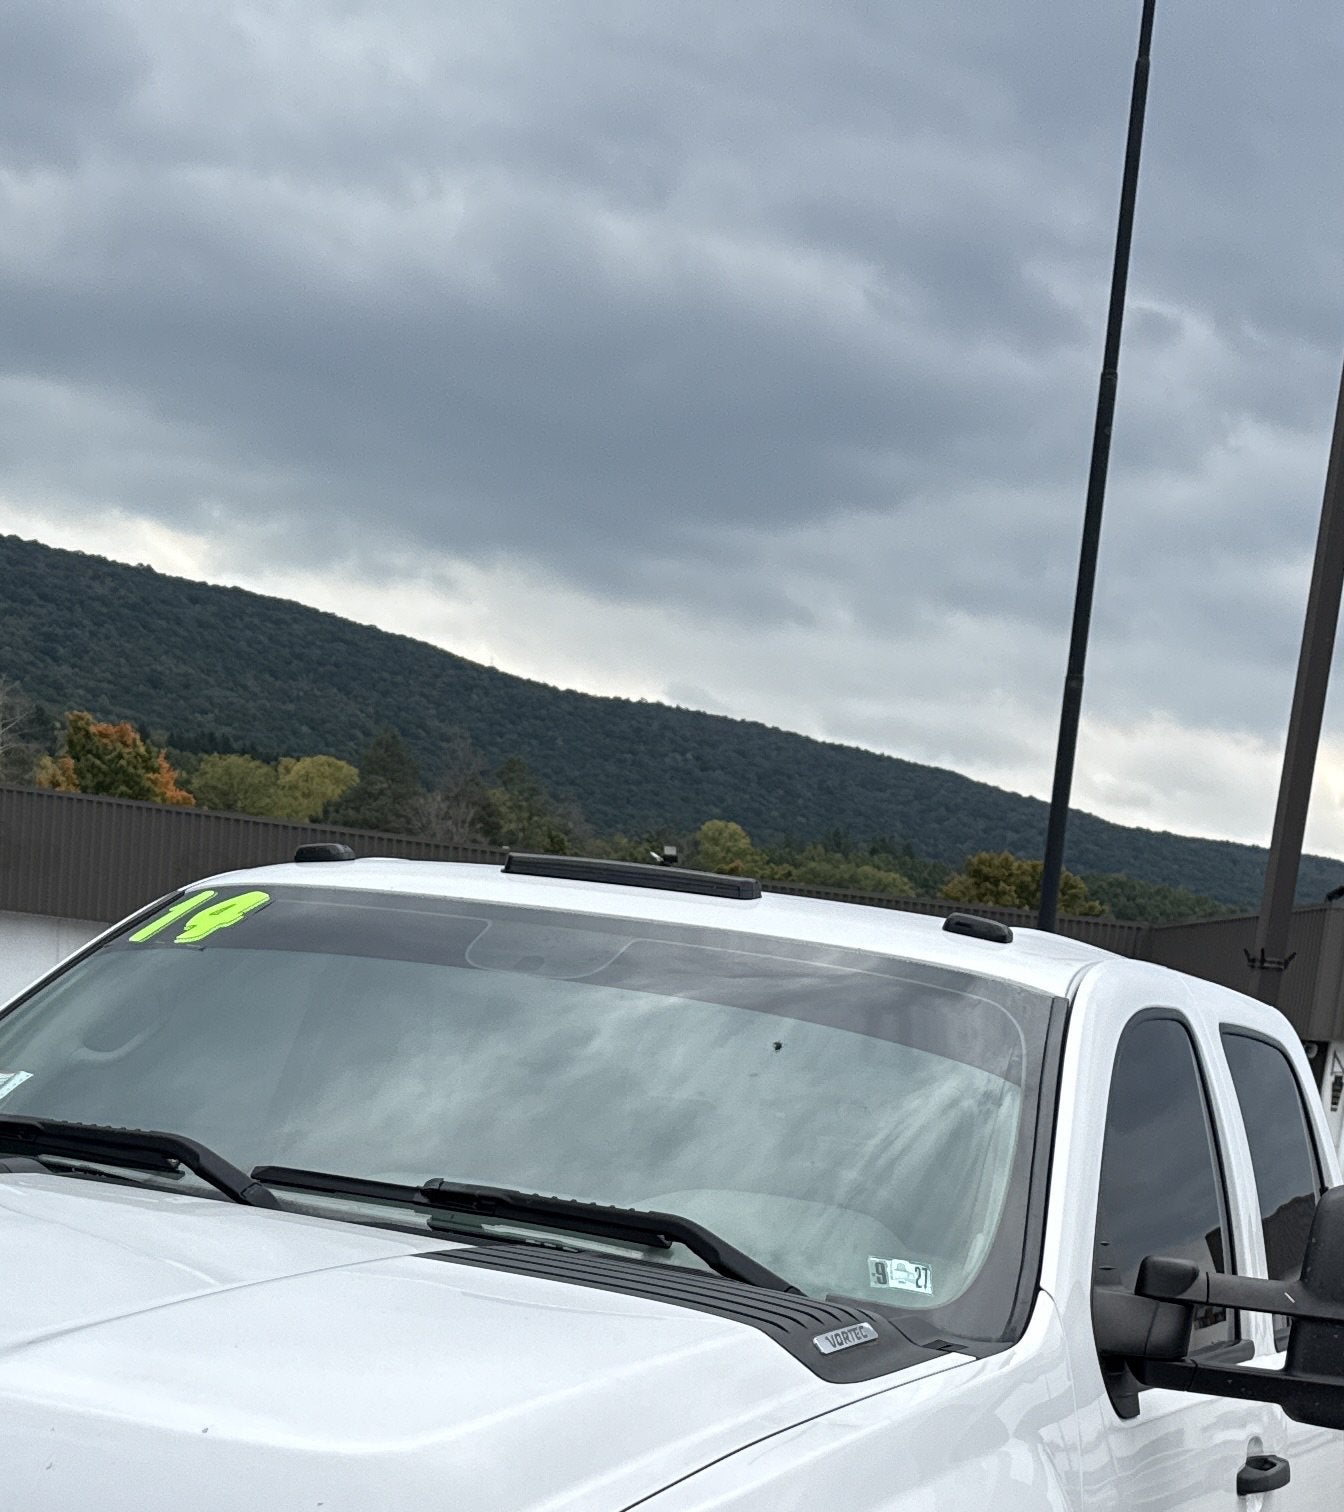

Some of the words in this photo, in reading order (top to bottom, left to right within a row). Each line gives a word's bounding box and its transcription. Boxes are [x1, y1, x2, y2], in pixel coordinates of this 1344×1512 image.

[128, 890, 271, 944] 14
[914, 1266, 928, 1290] 27
[825, 1325, 868, 1349] VORTEC
